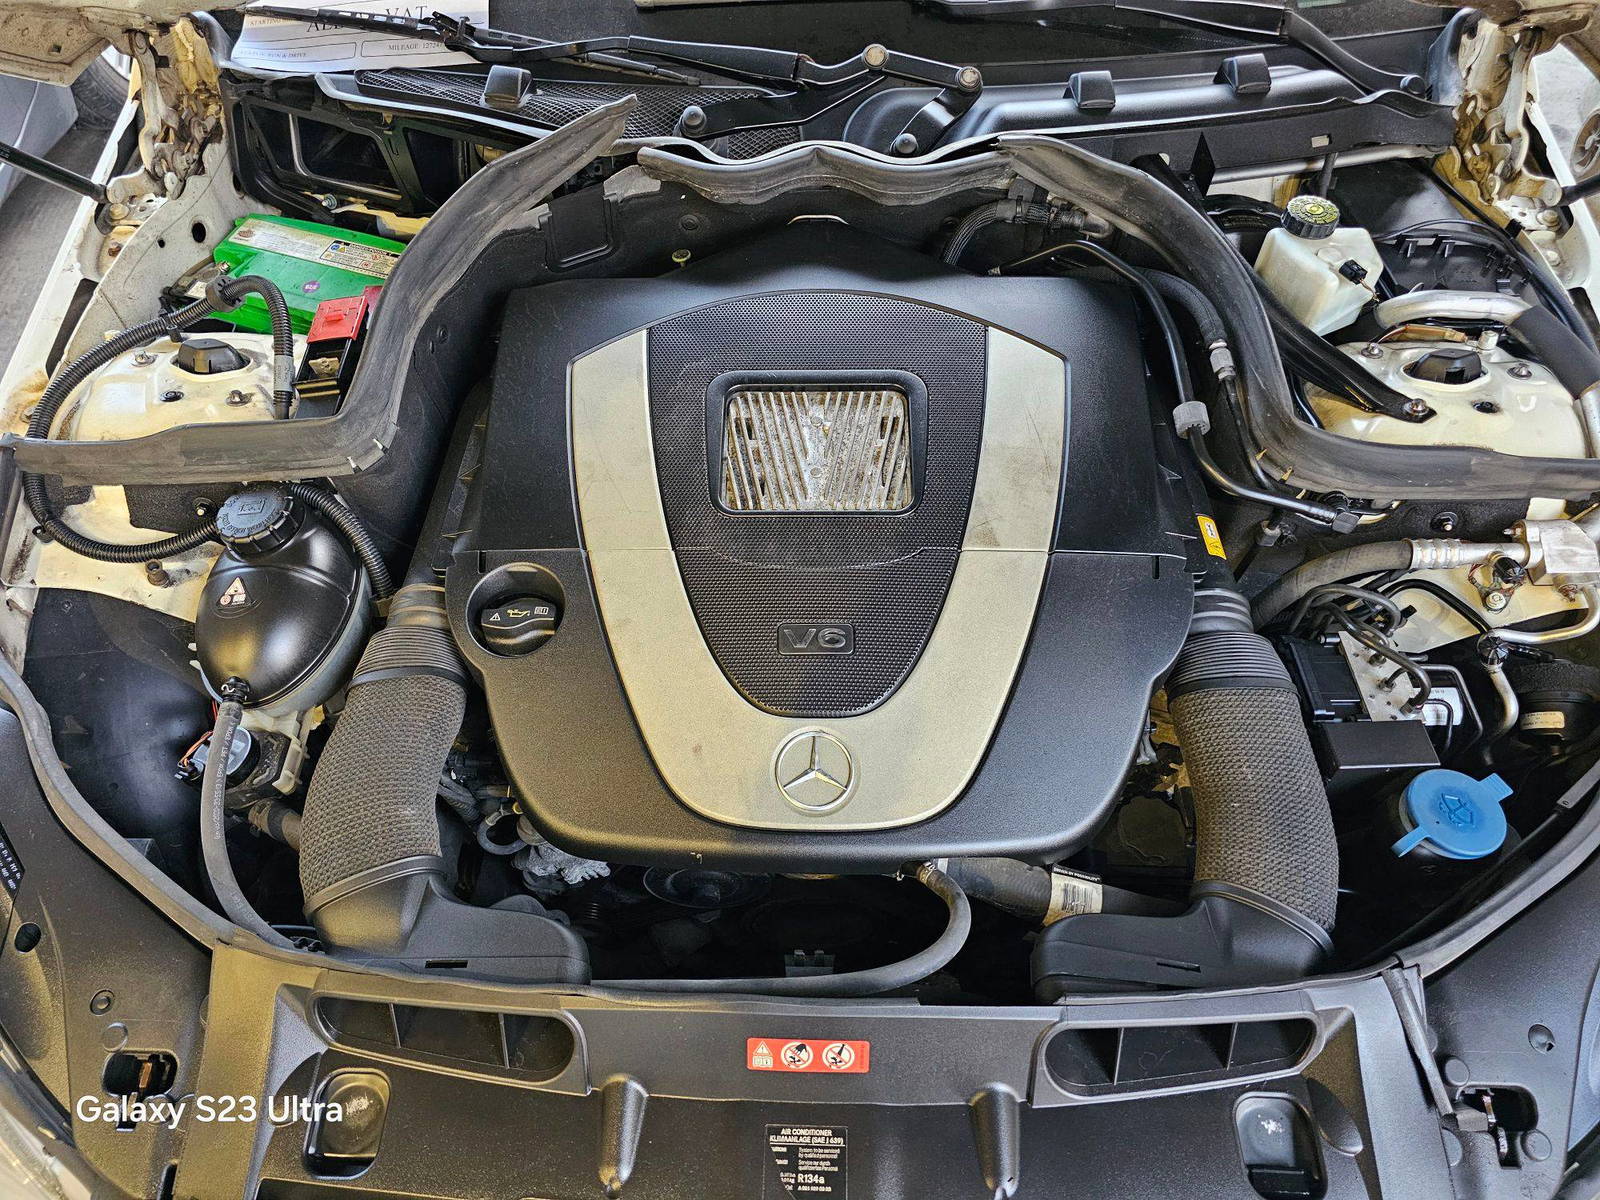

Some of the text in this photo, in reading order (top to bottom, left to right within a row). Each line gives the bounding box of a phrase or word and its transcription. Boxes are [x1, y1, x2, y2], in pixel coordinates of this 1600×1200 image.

[783, 627, 846, 648] V6
[792, 1128, 832, 1136] CONDITIONER
[770, 1135, 811, 1143] KLIMAANLAGE
[812, 1136, 825, 1144] (SAE
[797, 1173, 825, 1184] R134a
